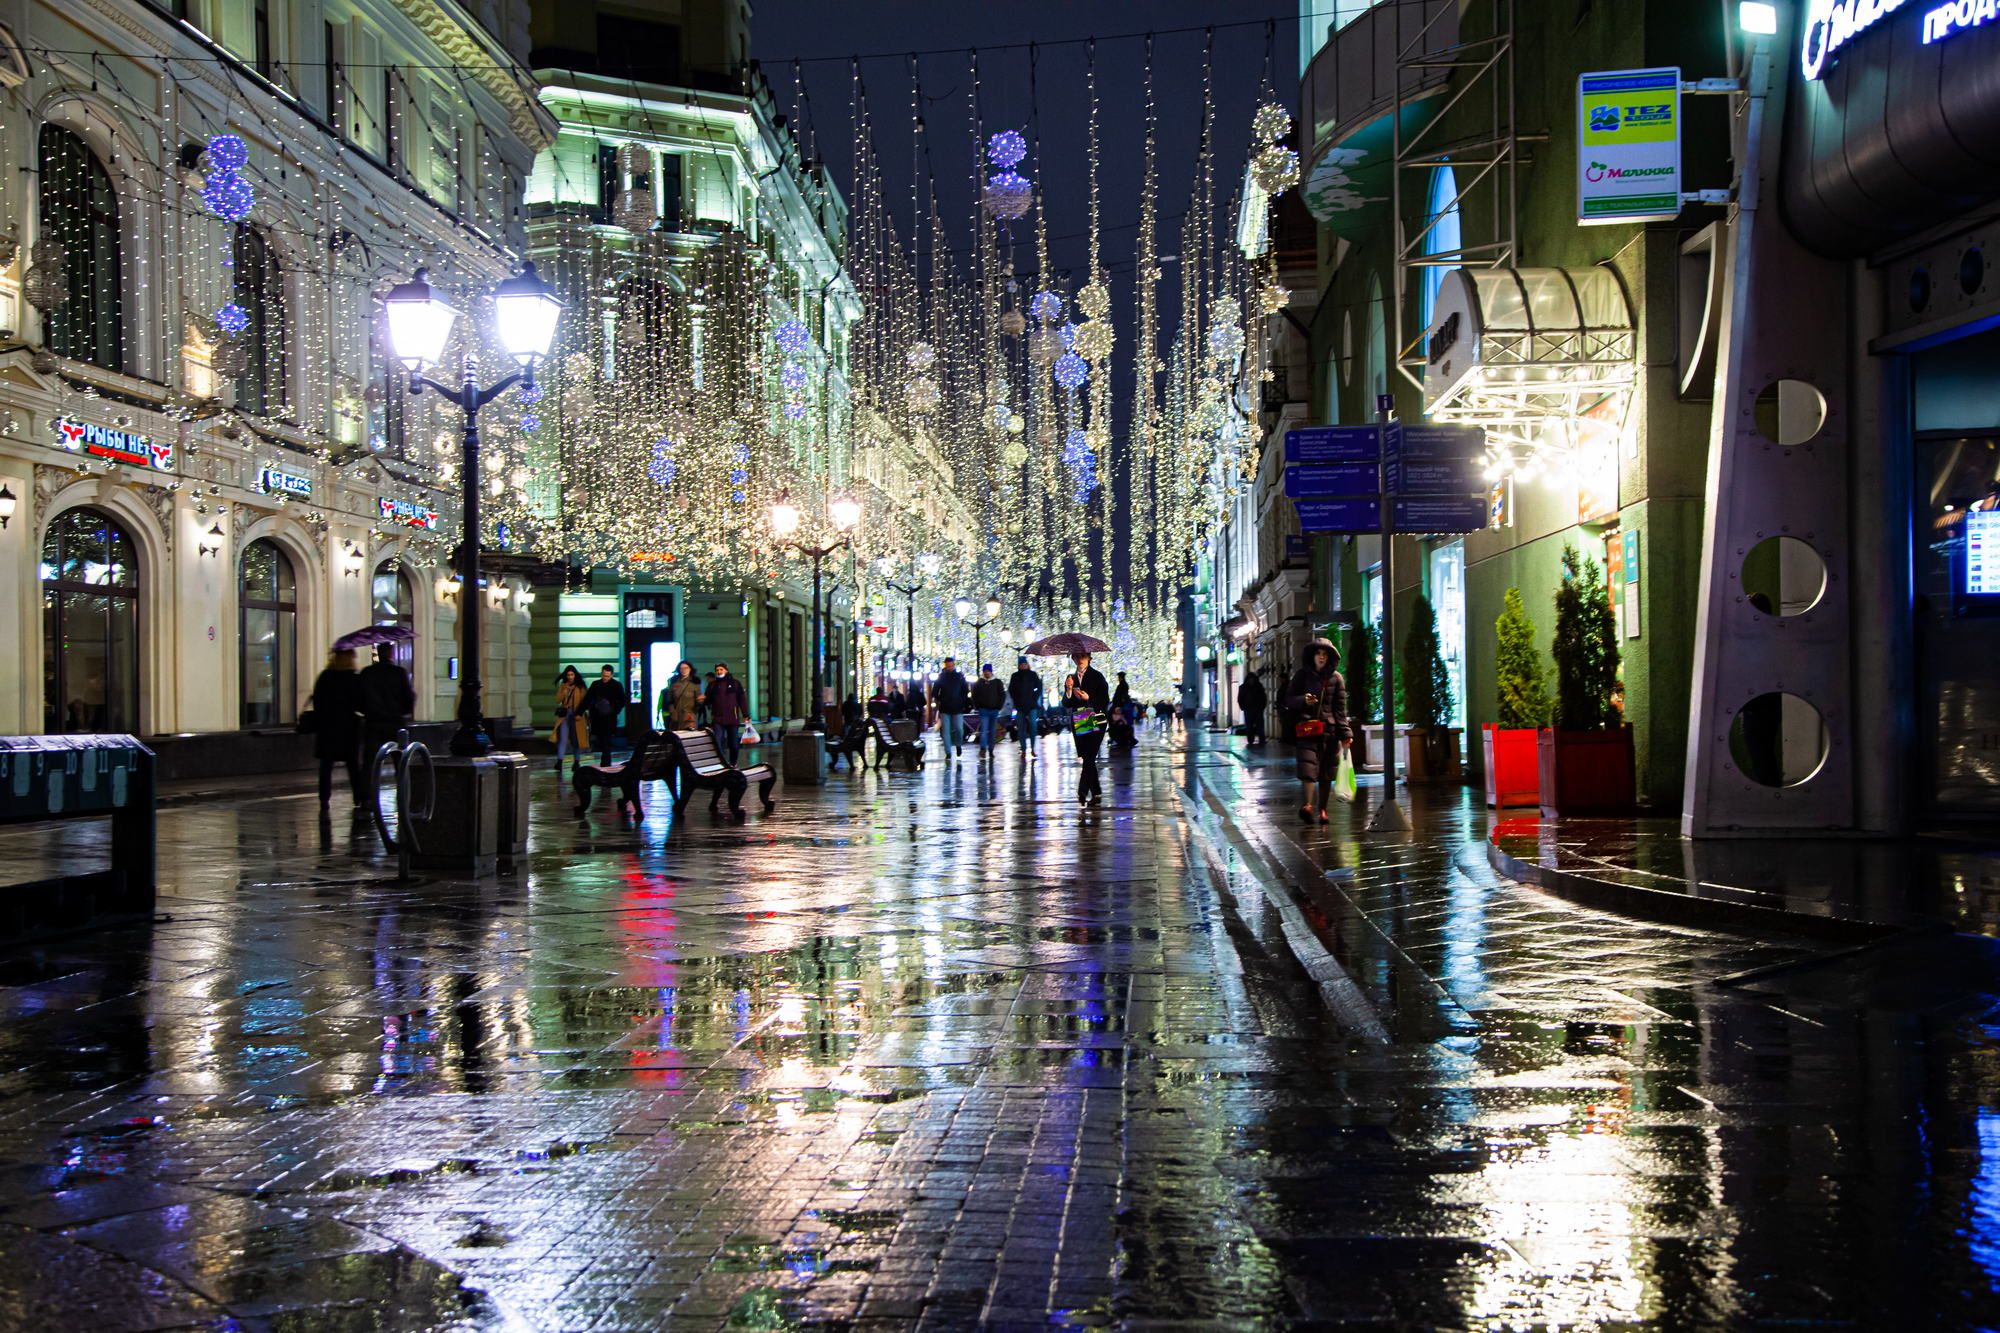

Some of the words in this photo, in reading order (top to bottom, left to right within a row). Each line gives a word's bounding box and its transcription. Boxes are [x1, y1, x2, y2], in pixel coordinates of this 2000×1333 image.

[1923, 0, 2000, 45] ПРОД
[1624, 104, 1671, 115] TEZ
[1607, 166, 1675, 178] Малинка
[86, 424, 126, 450] РЫБЫ
[37, 752, 45, 776] 9
[66, 751, 78, 775] 10
[98, 750, 109, 773] 11
